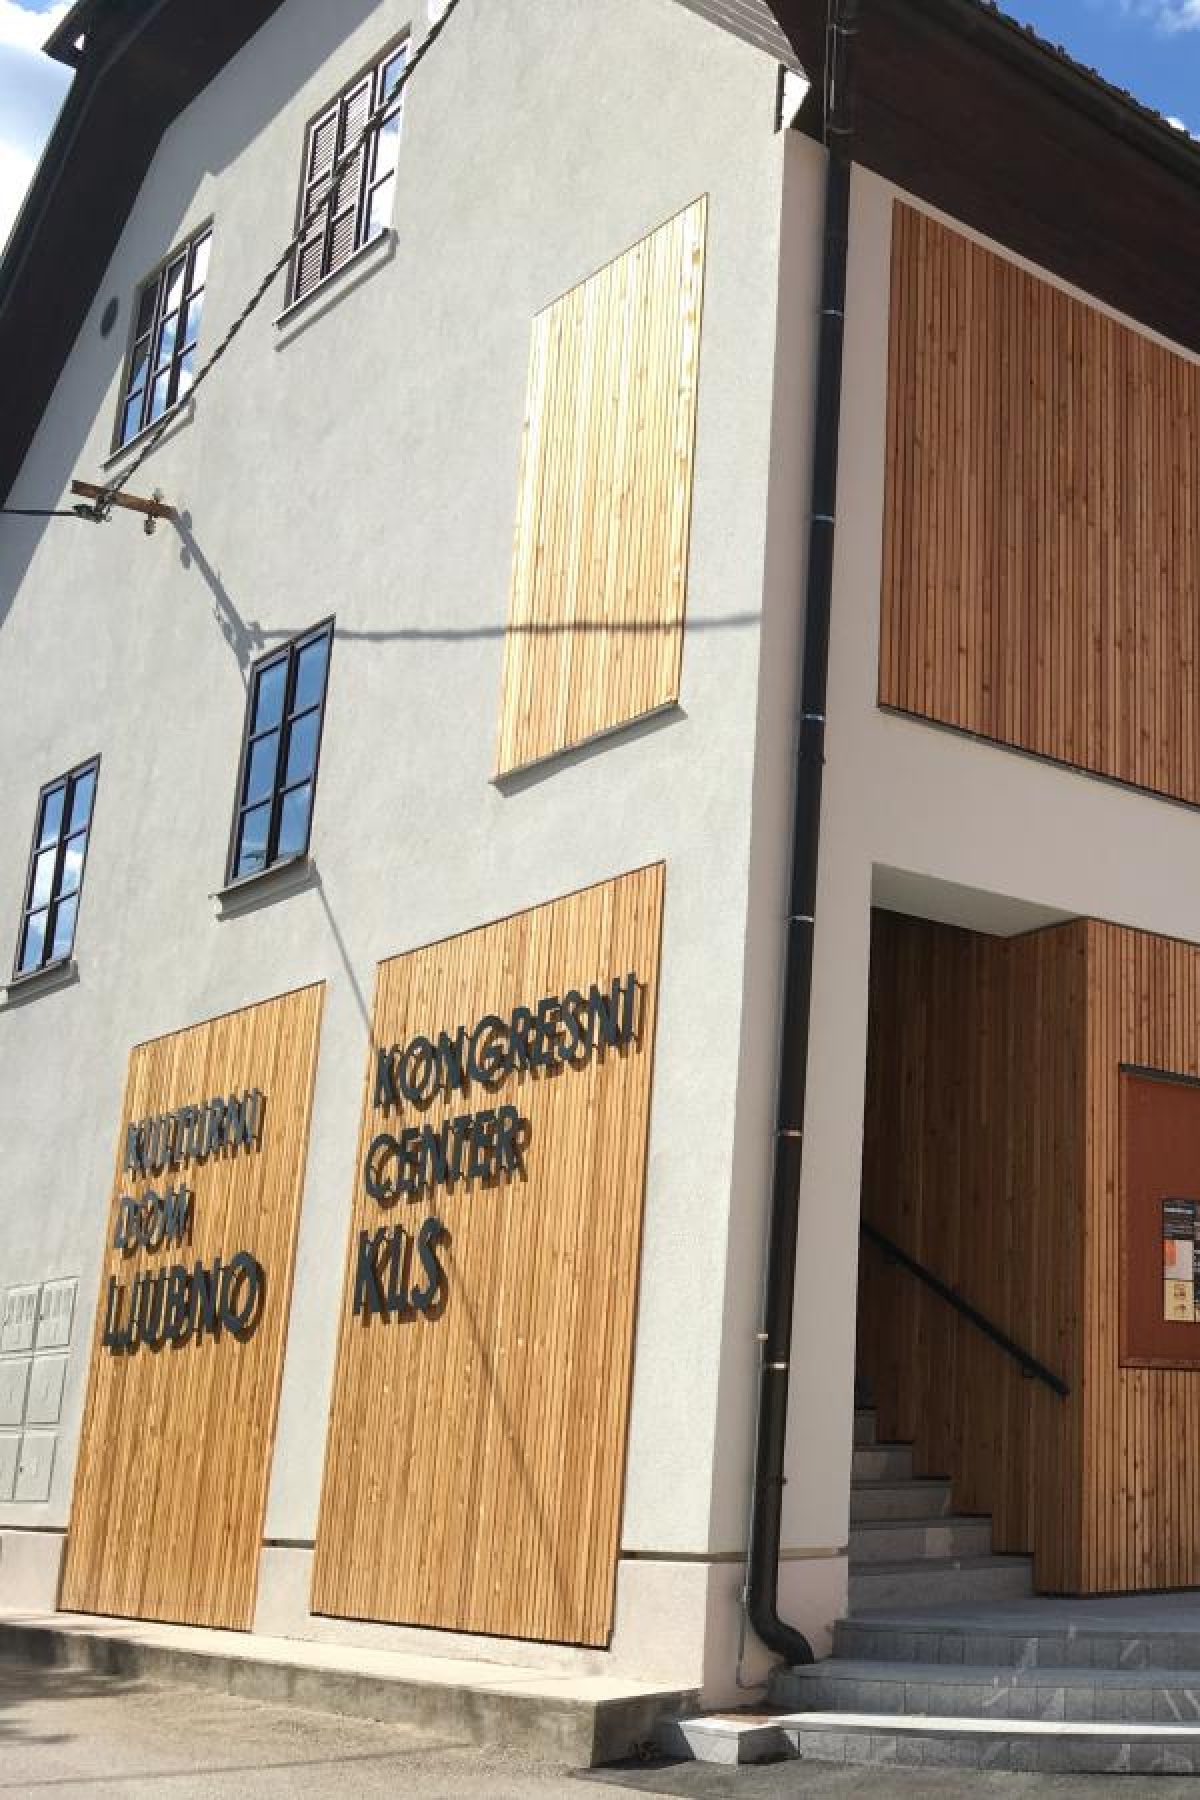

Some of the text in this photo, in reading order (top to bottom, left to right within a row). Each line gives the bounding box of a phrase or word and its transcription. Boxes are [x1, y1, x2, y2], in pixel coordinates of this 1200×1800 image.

[373, 972, 637, 1109] KONGRESNI
[124, 1088, 262, 1174] KULTURNI
[365, 1104, 522, 1200] CENTER
[114, 1184, 188, 1250] DOM
[105, 1251, 259, 1347] LJUBNO
[353, 1217, 449, 1316] KLS
